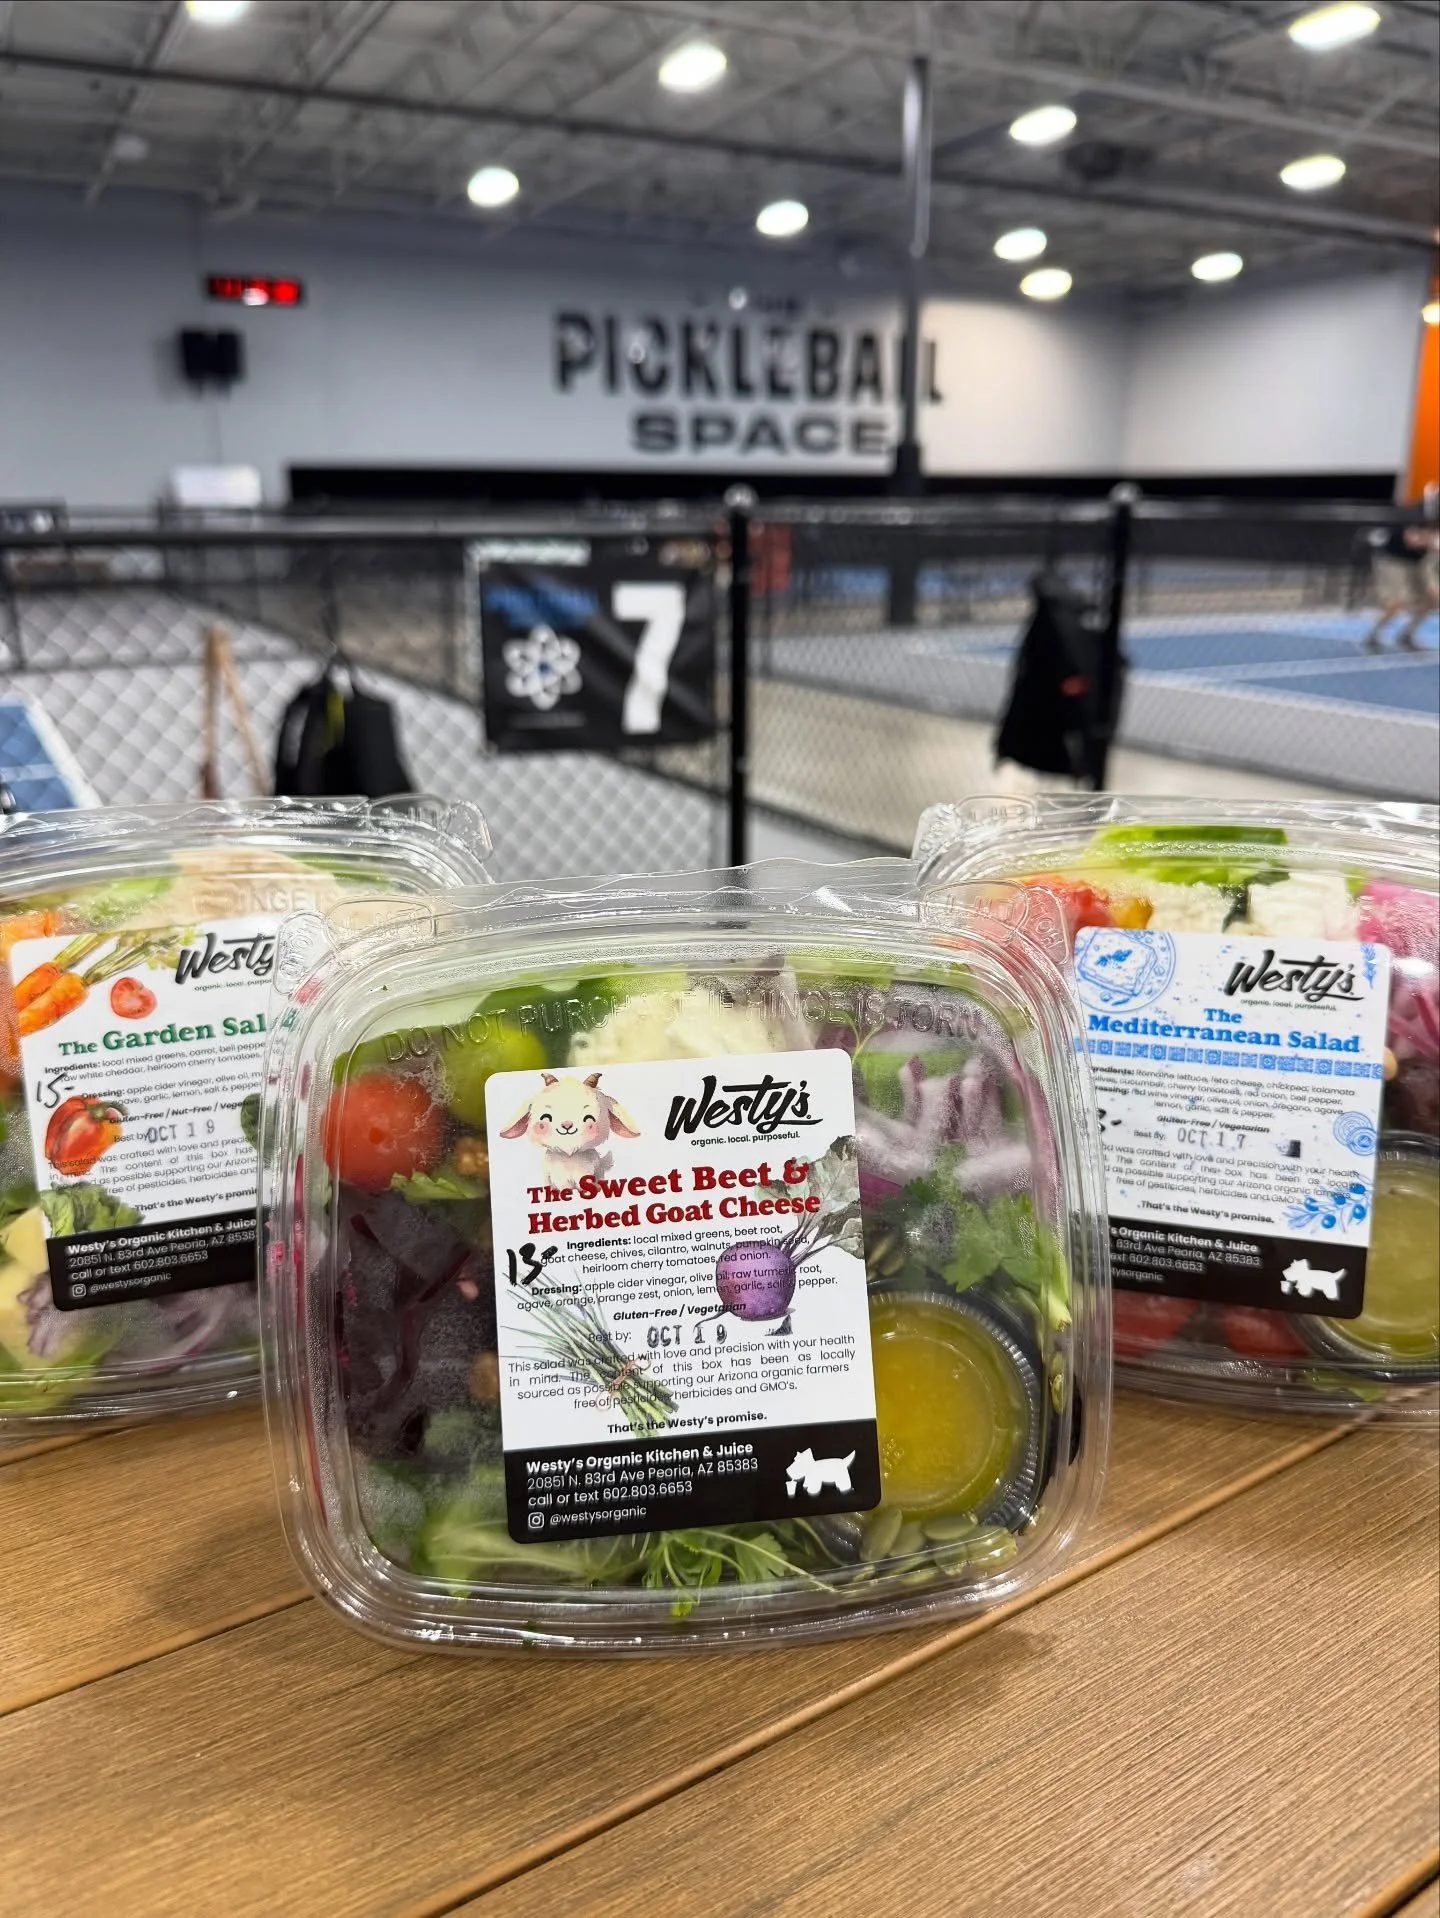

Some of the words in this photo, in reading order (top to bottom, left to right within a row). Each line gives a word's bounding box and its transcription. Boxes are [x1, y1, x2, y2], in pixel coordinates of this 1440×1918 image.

[554, 310, 942, 405] PICKLEBAL
[630, 412, 888, 455] SPACE
[611, 581, 685, 734] 7
[175, 932, 276, 985] Westy
[1203, 1008, 1243, 1024] The
[58, 1040, 98, 1056] The
[102, 1021, 216, 1051] Garden
[222, 1012, 268, 1037] Sal
[384, 1026, 431, 1063] DO
[442, 1009, 506, 1050] NOT
[1088, 1014, 1281, 1047] Mediterranean
[1287, 1031, 1361, 1053] Salad
[147, 1123, 178, 1144] OCT
[690, 1137, 727, 1147] organic.
[728, 1134, 750, 1144] local.
[752, 1131, 800, 1143] purposeful.
[1177, 1127, 1208, 1148] OCT
[527, 1186, 573, 1205] The
[578, 1169, 682, 1200] Sweet
[693, 1162, 771, 1192] Beet
[782, 1158, 810, 1184] &
[527, 1203, 643, 1234] Herbed
[646, 1199, 713, 1224] Goat
[718, 1194, 821, 1219] Cheese
[68, 1239, 116, 1256] Westy's
[118, 1231, 166, 1248] Organic
[168, 1225, 213, 1240] Kitchen
[215, 1221, 224, 1232] &
[226, 1217, 256, 1230] Juice
[70, 1254, 102, 1268] 20851
[104, 1253, 116, 1263] N.
[118, 1248, 144, 1260] 83rd
[147, 1246, 168, 1256] Ave
[170, 1239, 209, 1252] Peoria,
[211, 1235, 226, 1246] AZ
[566, 1238, 632, 1250] Ingredients:
[633, 1234, 659, 1244] local
[660, 1232, 692, 1242] mixed
[694, 1231, 733, 1241] greens,
[734, 1227, 758, 1236] beet
[760, 1225, 783, 1234] root,
[1119, 1226, 1166, 1240] Organic
[1168, 1232, 1212, 1246] Kitchen
[1214, 1238, 1223, 1248] &
[1225, 1239, 1258, 1252] Juice
[540, 1255, 566, 1266] goat
[567, 1253, 608, 1262] cheese,
[610, 1249, 646, 1259] chives,
[647, 1246, 688, 1256] cilantro,
[582, 1263, 628, 1274] heirloom
[631, 1261, 664, 1270] cherry
[740, 1252, 771, 1261] onion.
[71, 1268, 92, 1281] call
[95, 1268, 106, 1277] or
[110, 1263, 131, 1275] text
[532, 1284, 582, 1295] Dressing:
[584, 1281, 615, 1292] apple
[617, 1279, 644, 1288] cider
[646, 1277, 687, 1287] vinegar,
[689, 1273, 714, 1283] olive
[799, 1265, 822, 1274] root,
[517, 1301, 554, 1311] agave,
[598, 1294, 636, 1303] orange
[638, 1290, 661, 1300] zest,
[663, 1288, 695, 1298] onion,
[734, 1282, 766, 1294] garlic,
[798, 1278, 838, 1289] pepper.
[613, 1308, 678, 1321] Gluten-Free
[678, 1306, 685, 1317] /
[615, 1331, 632, 1345] by:
[646, 1324, 683, 1348] OCT
[508, 1362, 531, 1372] This
[533, 1358, 565, 1370] salad
[567, 1359, 591, 1367] was
[636, 1350, 661, 1361] with
[663, 1350, 687, 1359] love
[689, 1346, 712, 1357] and
[714, 1343, 764, 1357] precision
[768, 1340, 790, 1350] with
[792, 1340, 816, 1350] your
[820, 1334, 855, 1346] health
[509, 1377, 520, 1386] in
[570, 1371, 590, 1381] The
[652, 1364, 664, 1374] of
[673, 1362, 692, 1372] this
[702, 1360, 722, 1369] box
[731, 1358, 752, 1367] has
[760, 1355, 789, 1364] been
[820, 1348, 856, 1359] locally
[517, 1386, 564, 1399] sourced
[567, 1387, 580, 1395] as
[696, 1376, 715, 1384] our
[718, 1371, 758, 1382] Arizona
[761, 1366, 804, 1379] organic
[806, 1364, 849, 1374] farmers
[574, 1399, 597, 1408] free
[674, 1386, 732, 1399] herbicides
[735, 1383, 756, 1394] and
[608, 1422, 644, 1433] That's
[646, 1420, 666, 1430] the
[668, 1416, 714, 1428] Westy's
[716, 1412, 768, 1426] promise.
[526, 1458, 584, 1474] Westy's
[586, 1453, 643, 1470] Organic
[646, 1448, 700, 1463] Kitchen
[703, 1446, 714, 1457] &
[716, 1443, 753, 1456] Juice
[527, 1476, 565, 1490] 20851
[568, 1475, 582, 1486] N.
[585, 1471, 616, 1485] 83rd
[620, 1470, 646, 1482] Ave
[648, 1465, 694, 1479] Peoria,
[698, 1462, 714, 1475] AZ
[717, 1458, 758, 1473] 85383
[528, 1493, 553, 1507] call
[556, 1495, 570, 1504] or
[574, 1490, 599, 1503] text
[602, 1481, 693, 1500] 602.803.6653
[549, 1505, 647, 1527] @westysorganic
